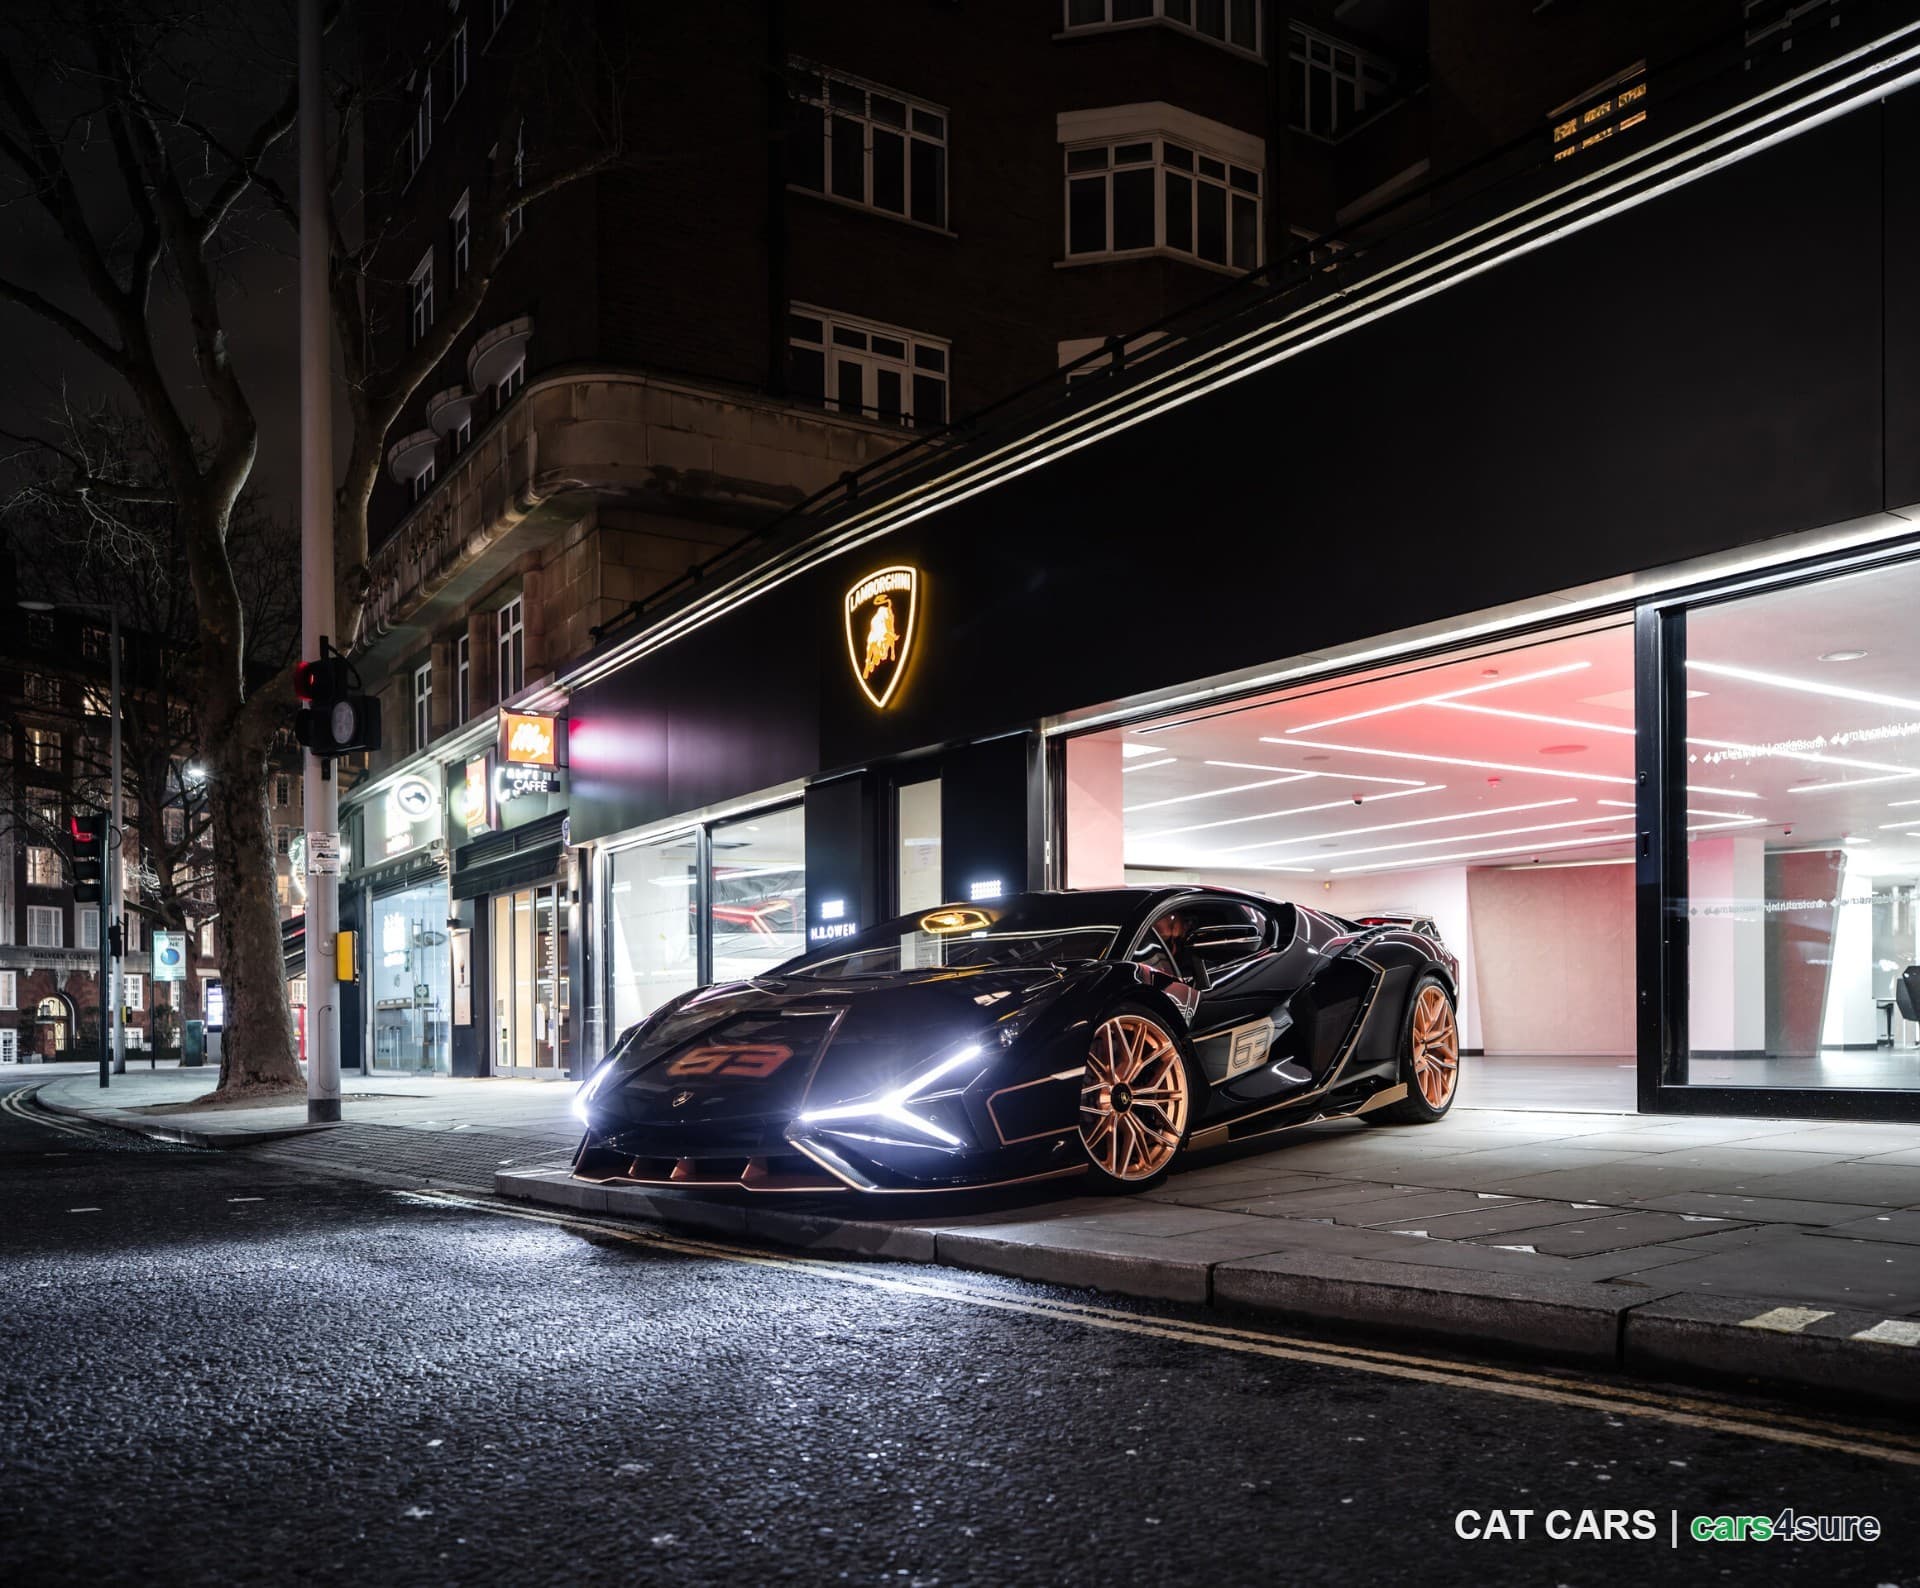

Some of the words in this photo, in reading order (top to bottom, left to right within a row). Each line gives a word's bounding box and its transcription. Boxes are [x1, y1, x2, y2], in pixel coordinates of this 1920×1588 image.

[850, 572, 911, 613] LAMBORGHINI
[666, 1044, 794, 1078] 63
[1232, 1023, 1271, 1070] 63
